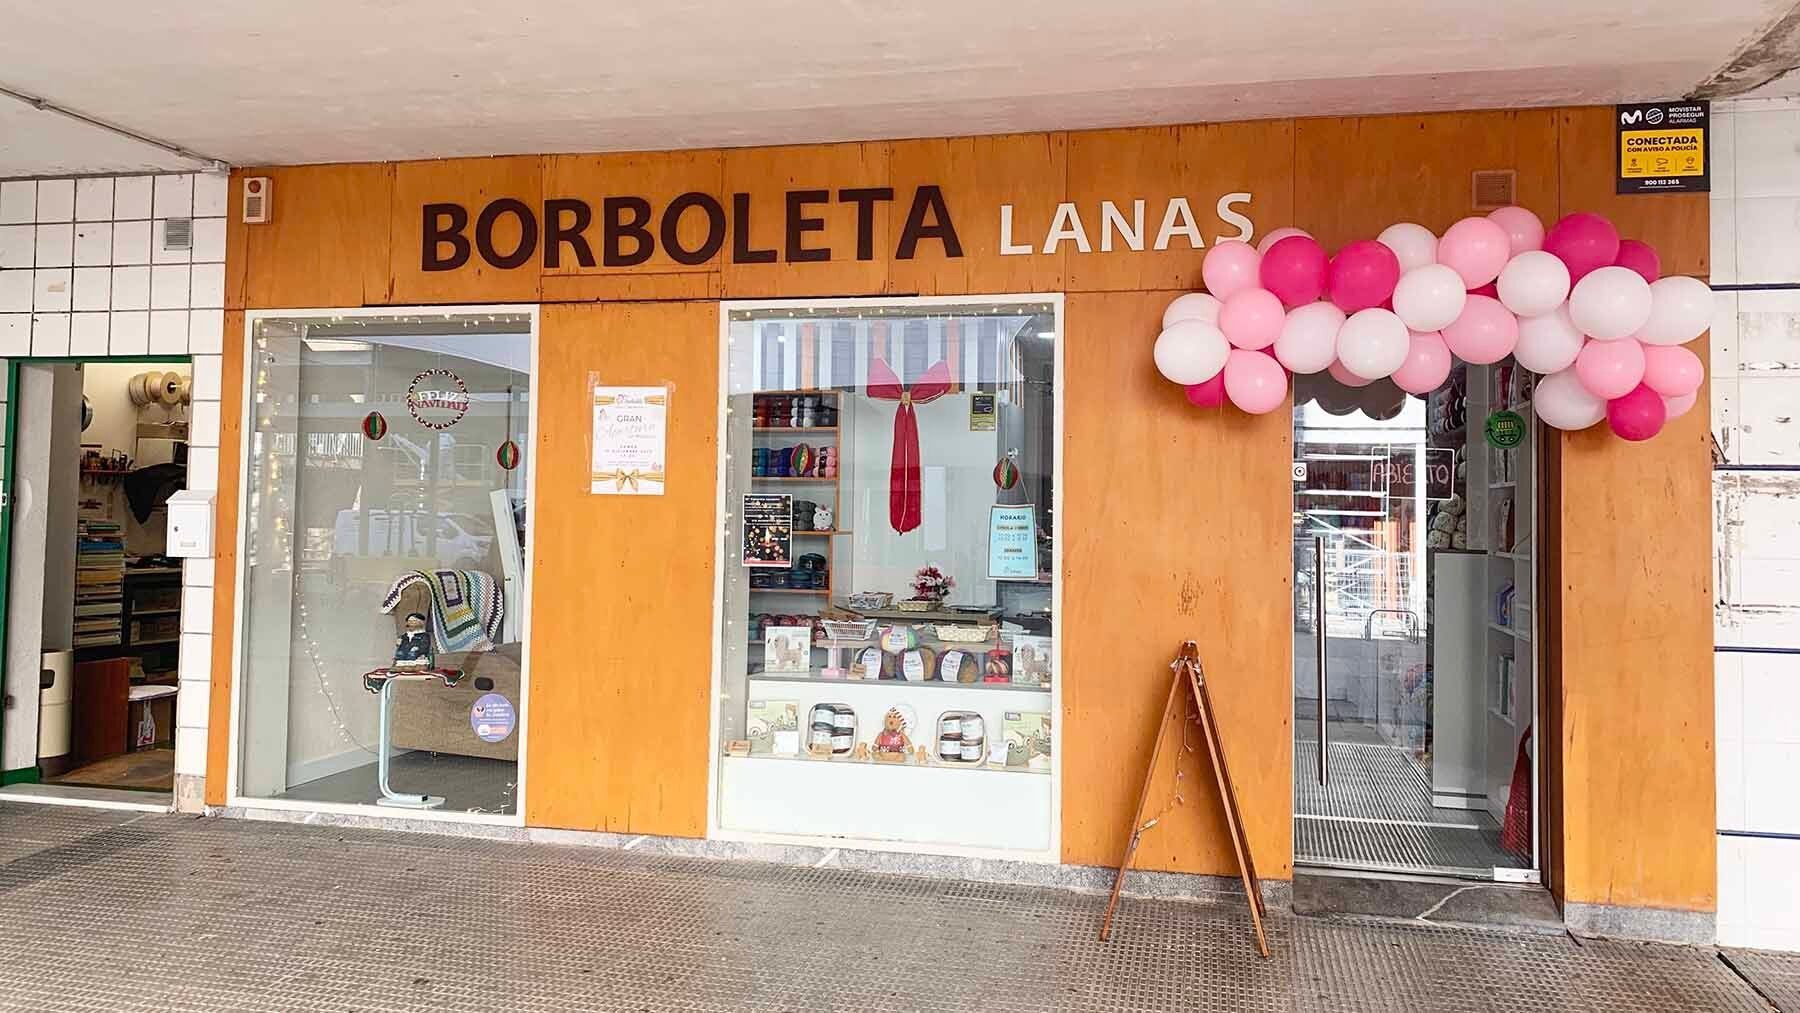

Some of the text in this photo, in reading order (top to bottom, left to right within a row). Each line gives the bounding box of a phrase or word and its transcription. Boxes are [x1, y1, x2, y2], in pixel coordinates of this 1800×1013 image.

[1626, 136, 1698, 145] CONECTADA
[421, 185, 1255, 271] BORBOLETA LANAS
[616, 415, 642, 423] GRAN
[1373, 462, 1449, 484] ABIETO
